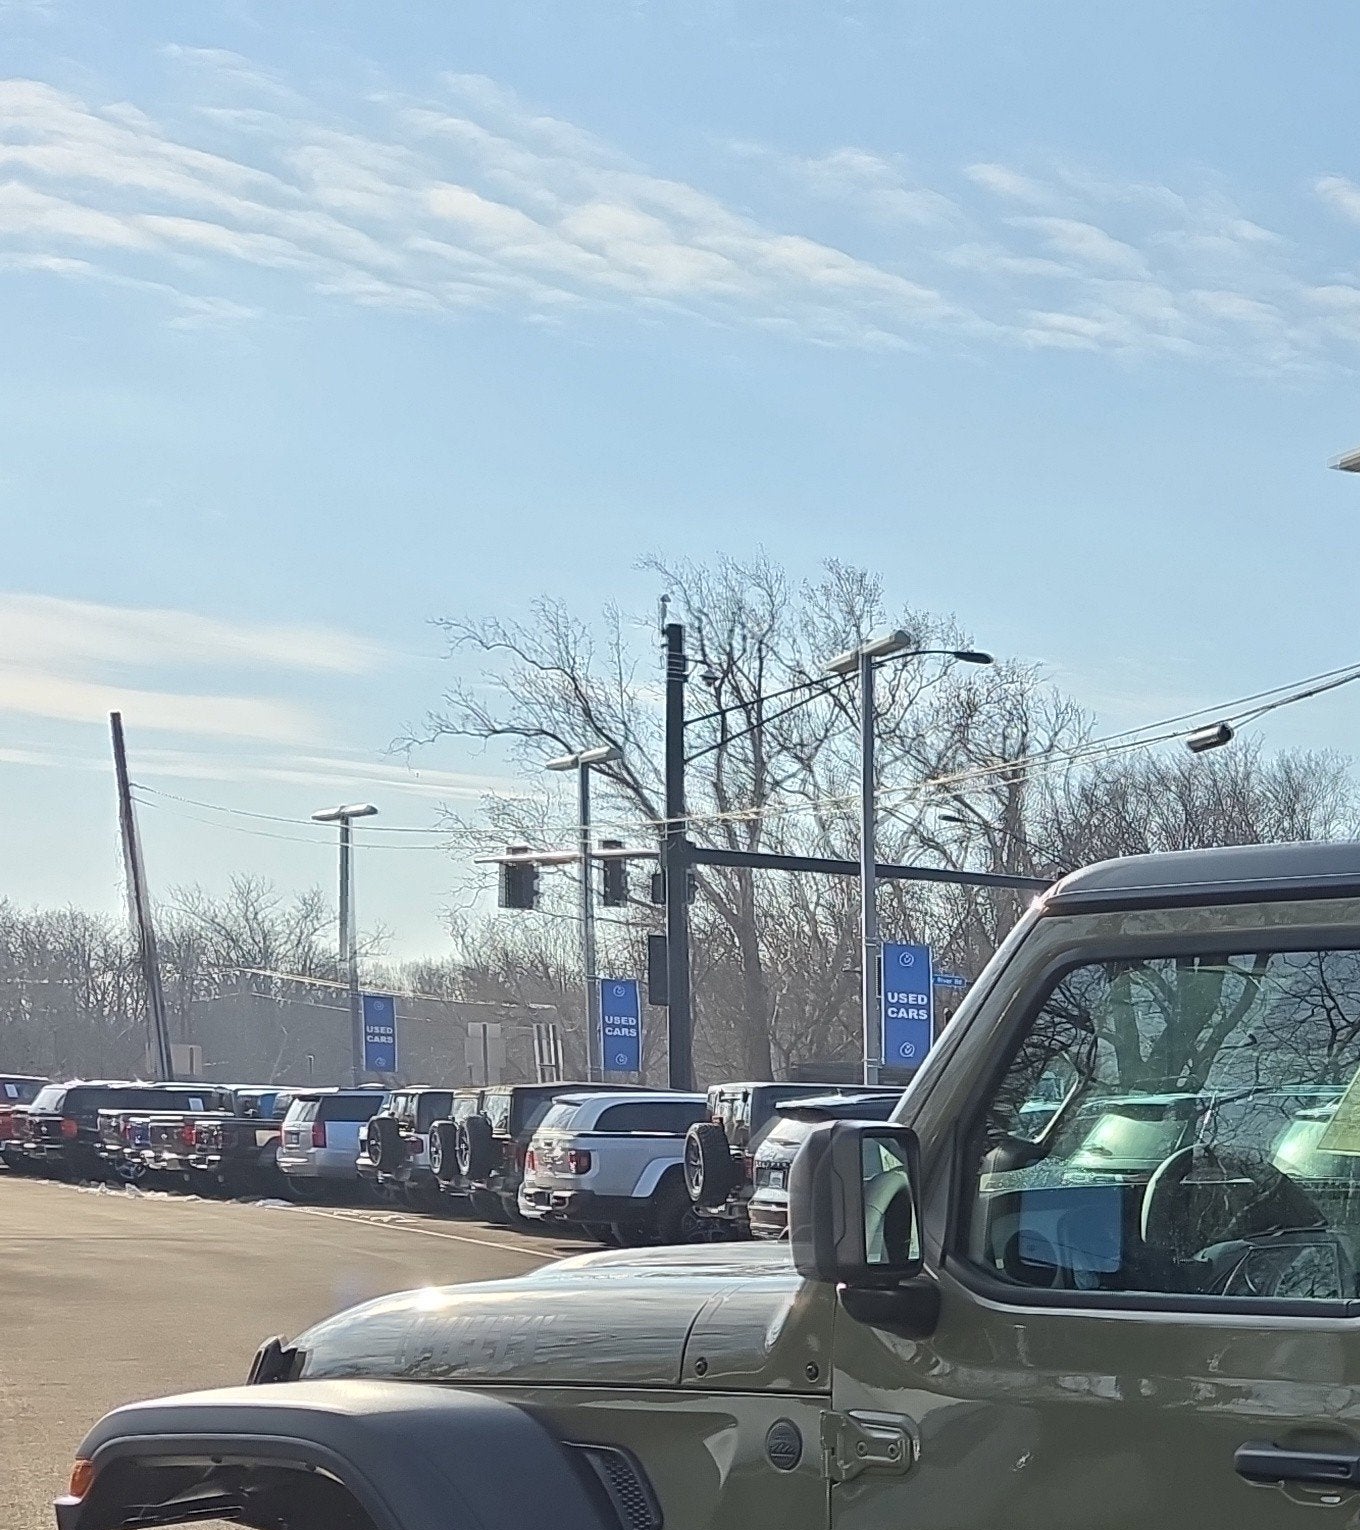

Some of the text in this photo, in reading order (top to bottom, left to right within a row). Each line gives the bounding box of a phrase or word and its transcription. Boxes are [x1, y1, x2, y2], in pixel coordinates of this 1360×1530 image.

[887, 992, 928, 1005] USED
[887, 1007, 928, 1020] CARS
[604, 1015, 637, 1026] USED
[366, 1025, 393, 1034] USED
[604, 1027, 637, 1037] CARS
[366, 1035, 394, 1044] CARS
